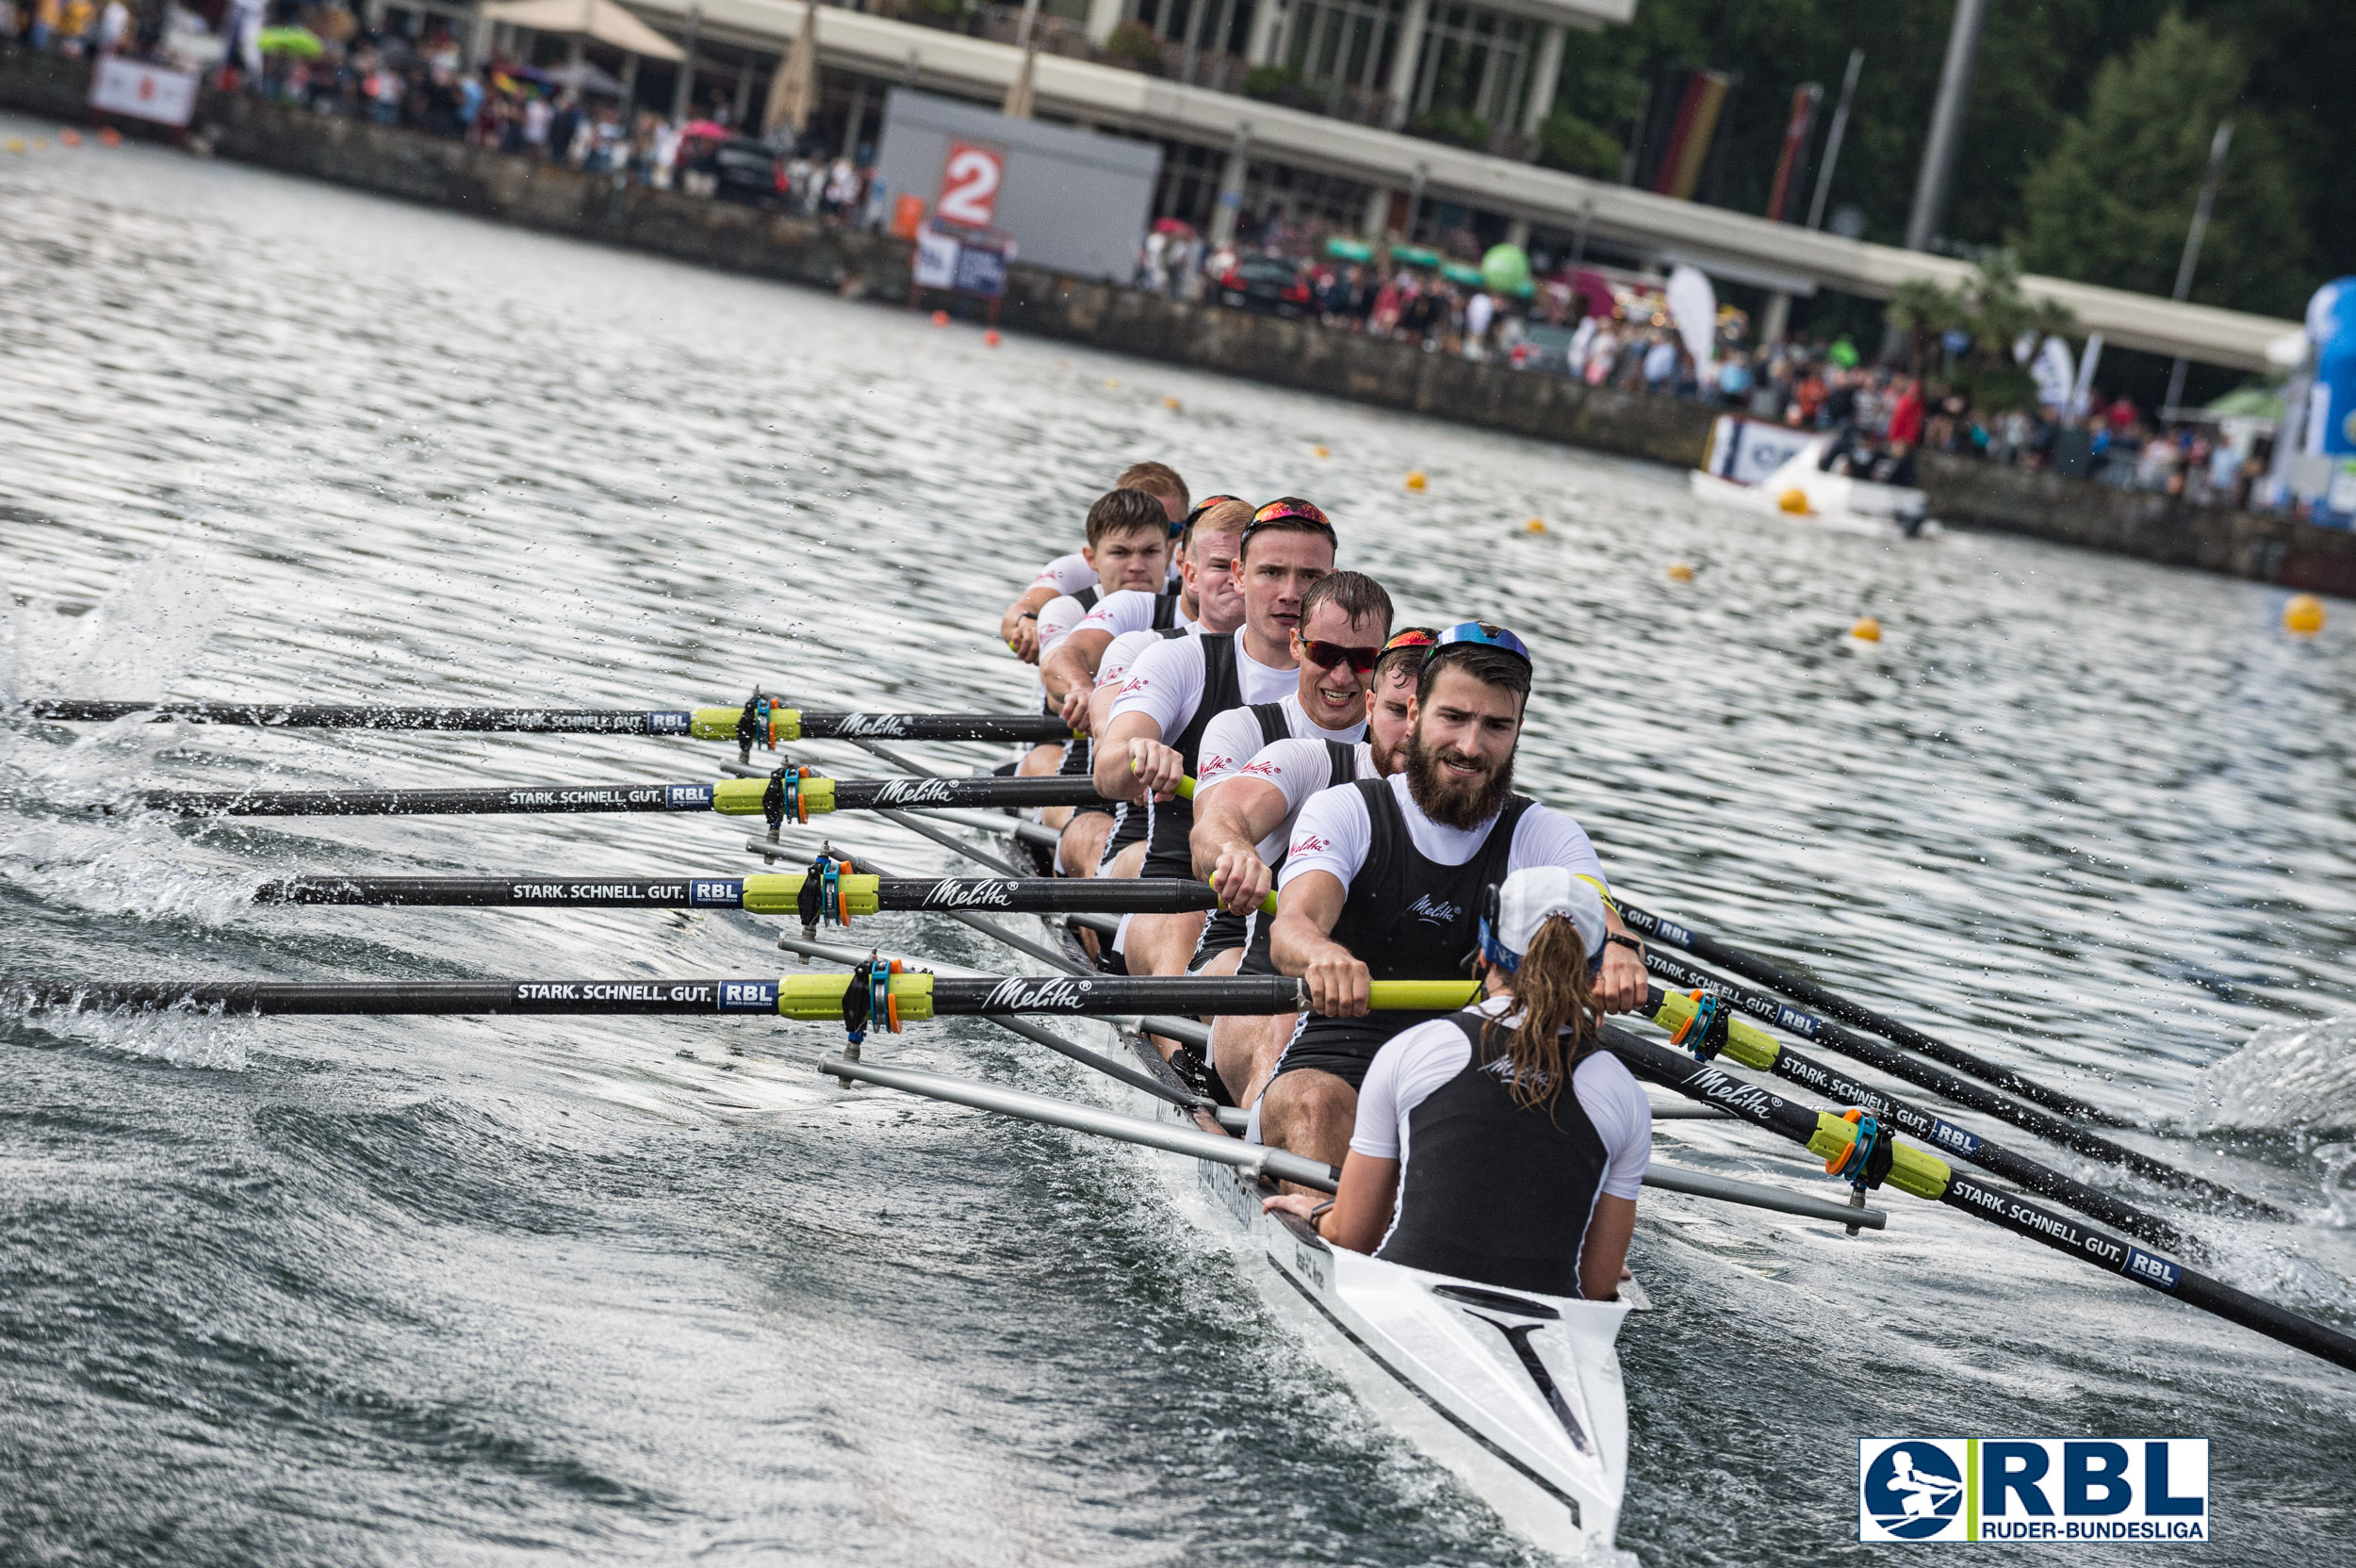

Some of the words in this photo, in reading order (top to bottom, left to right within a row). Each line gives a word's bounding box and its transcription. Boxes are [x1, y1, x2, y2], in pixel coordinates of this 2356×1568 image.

[942, 153, 999, 223] 2
[653, 715, 687, 727] RBL
[509, 791, 558, 805] STARK.
[560, 791, 627, 803] SCHNELL.
[629, 790, 662, 803] GUT.
[672, 788, 710, 801] RBL
[514, 884, 567, 899] STARK.
[570, 885, 646, 899] SCHNELL.
[647, 886, 684, 900] GUT.
[696, 883, 738, 898] RBL
[1628, 910, 1654, 929] GUT.
[1661, 922, 1690, 946] RBL
[517, 984, 579, 1000] STARK.
[582, 985, 667, 1001] SCHNELL.
[670, 986, 712, 1002] GUT.
[726, 985, 773, 1002] RBL
[1645, 955, 1686, 980] STARK.
[1687, 972, 1743, 1004] SCHNELL.
[1745, 997, 1774, 1018] GUT.
[1781, 1009, 1813, 1034] RBL
[1780, 1056, 1828, 1087] STARK.
[1829, 1079, 1893, 1118] SCHNELL.
[1938, 1124, 1974, 1152] RBL
[1952, 1181, 2006, 1215] STARK.
[2008, 1204, 2081, 1247] SCHNELL.
[2085, 1236, 2120, 1263] GUT.
[2132, 1252, 2174, 1283] RBL
